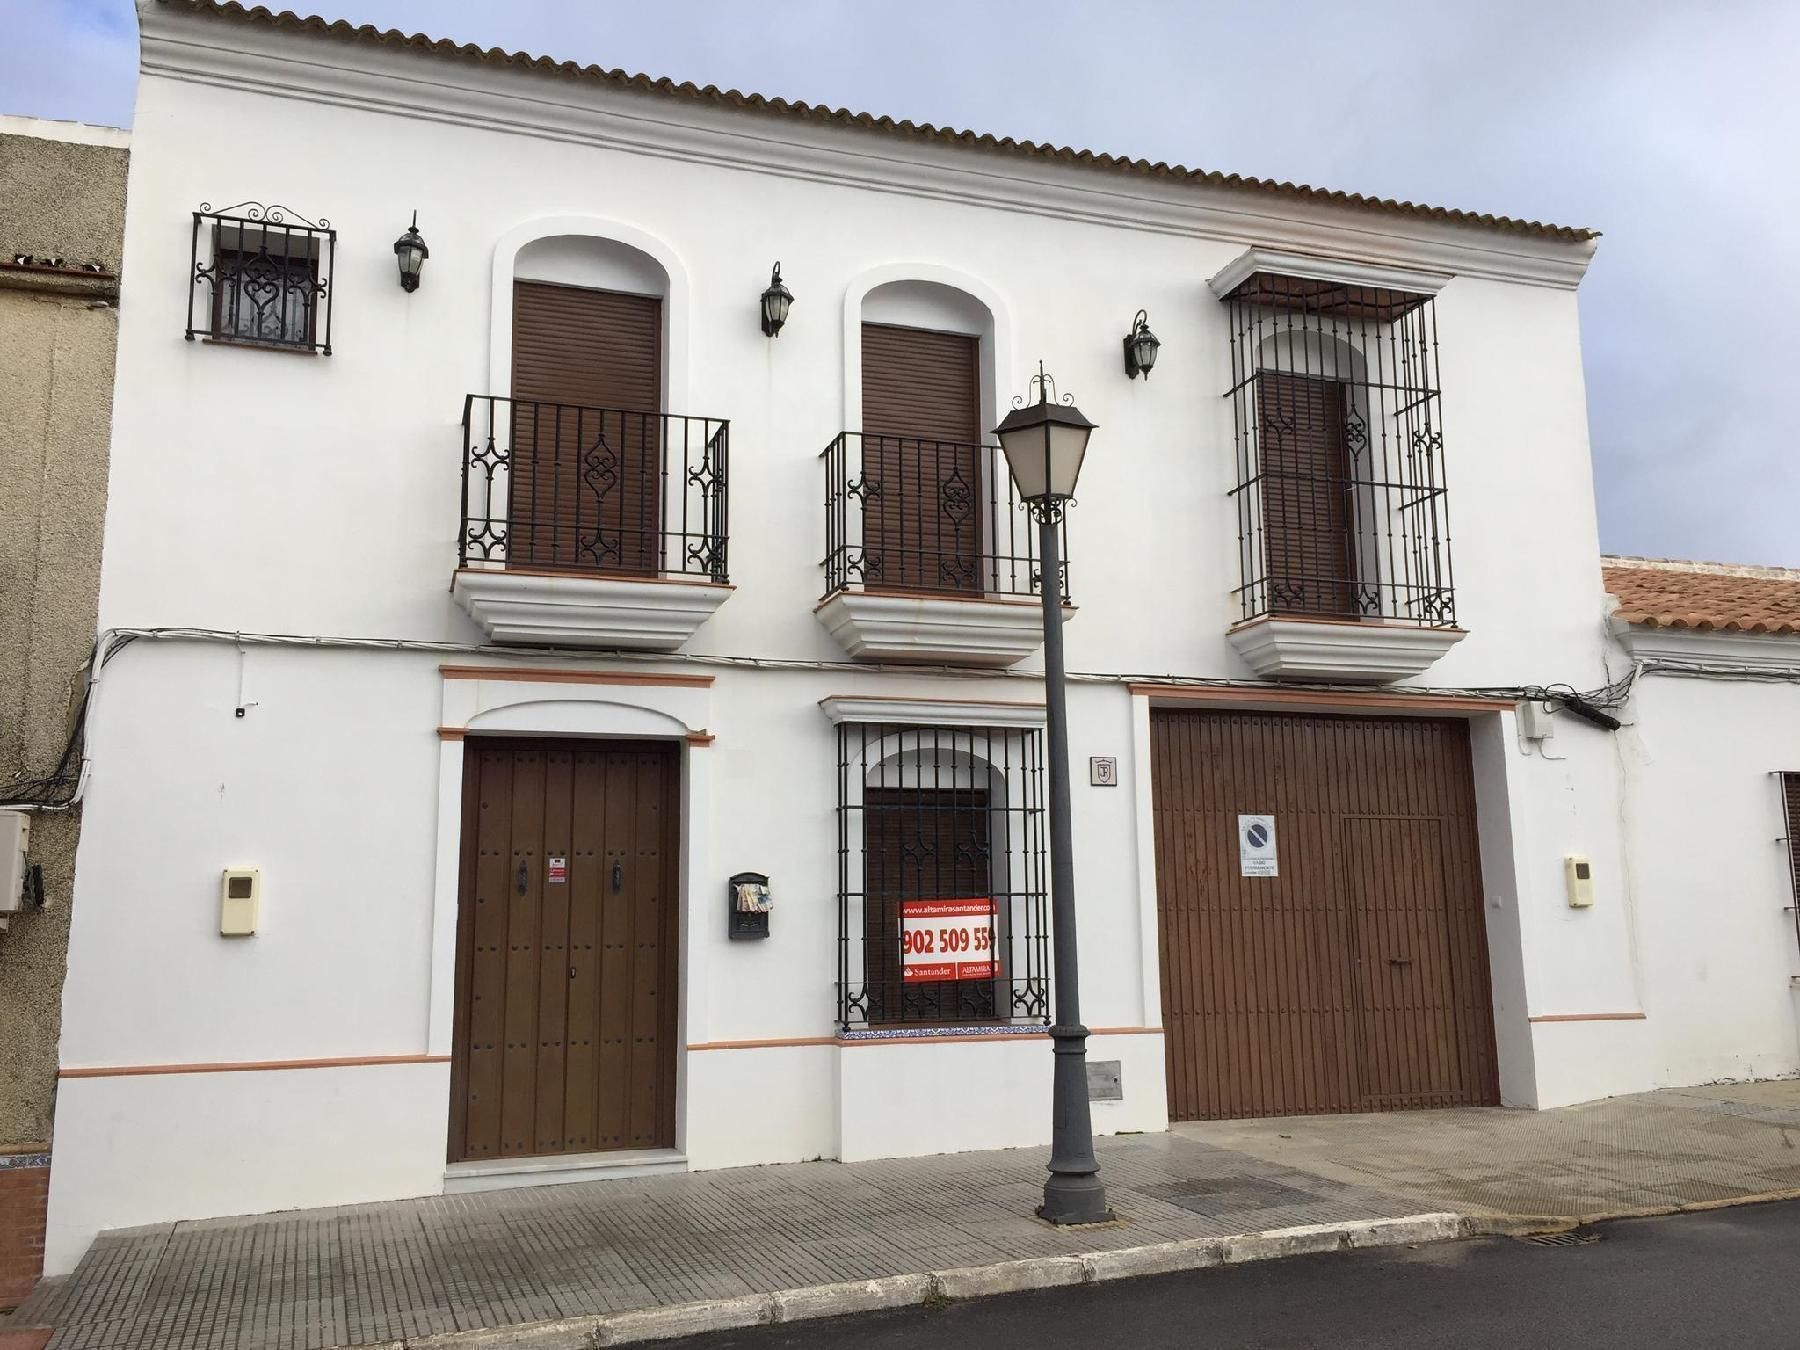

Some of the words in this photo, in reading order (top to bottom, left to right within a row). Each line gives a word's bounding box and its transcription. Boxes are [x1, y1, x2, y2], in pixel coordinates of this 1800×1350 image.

[904, 904, 996, 914] www.altamirasantander.co
[904, 929, 934, 954] 902
[940, 928, 970, 952] 509
[914, 967, 951, 977] Santander
